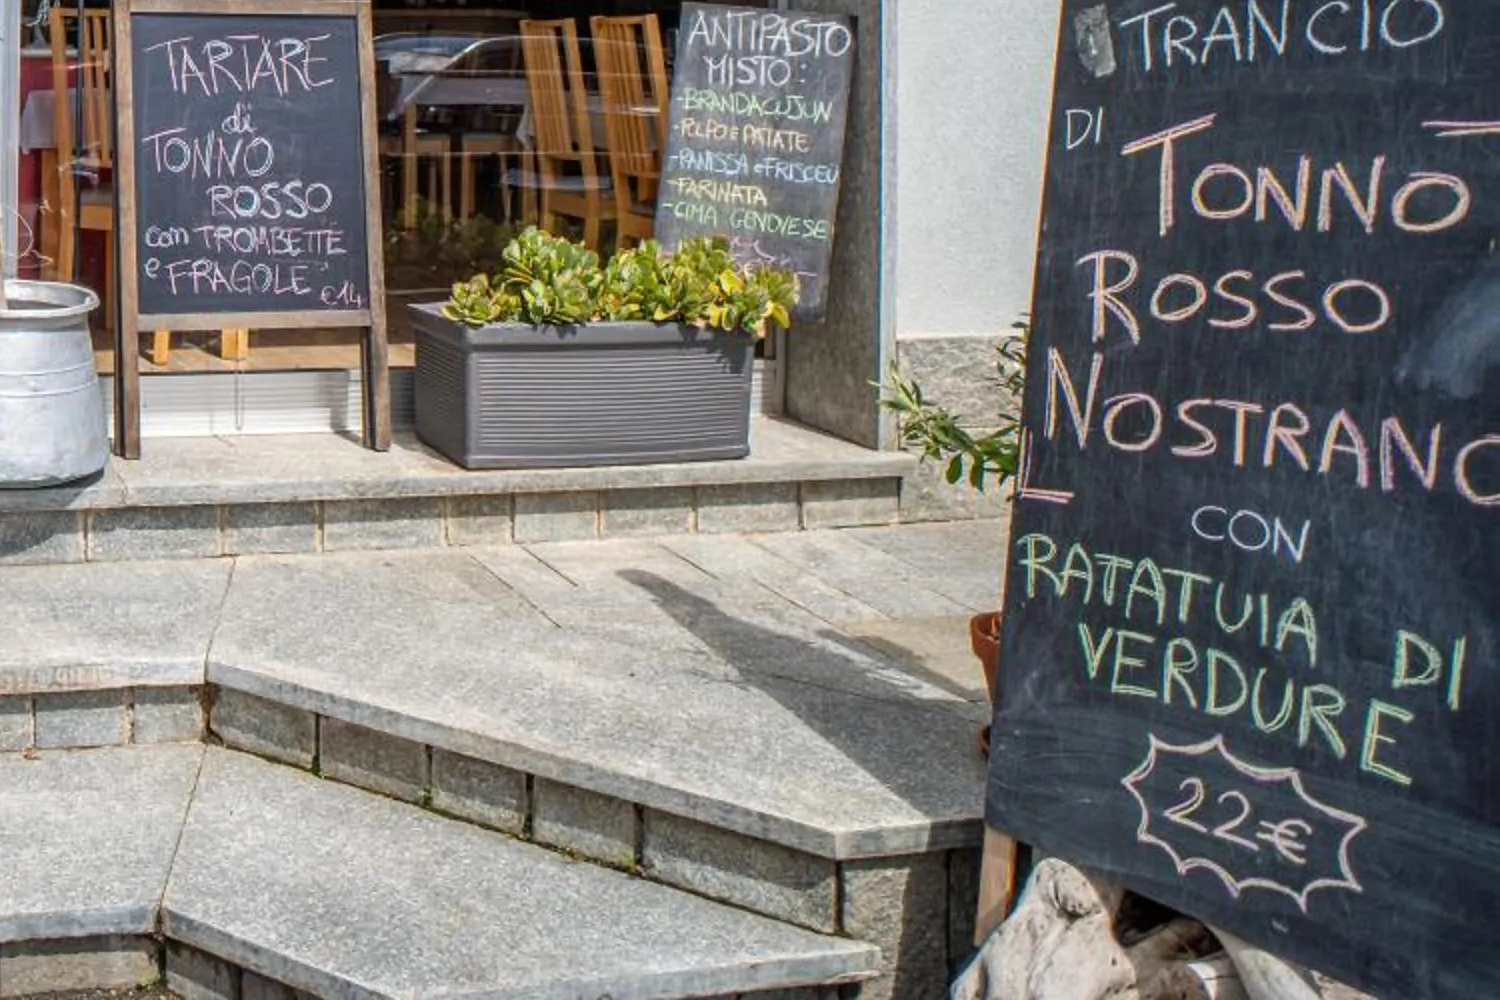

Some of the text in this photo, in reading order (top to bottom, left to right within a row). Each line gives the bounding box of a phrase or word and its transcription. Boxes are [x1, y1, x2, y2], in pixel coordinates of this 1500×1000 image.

[688, 10, 851, 57] ANTIPASTO
[144, 33, 334, 97] TARTARE
[222, 102, 258, 134] di
[743, 123, 810, 153] PATATE
[142, 128, 275, 179] TONNO
[1065, 106, 1471, 237] DI TONNO
[206, 182, 333, 219] ROSSO
[730, 207, 829, 239] GENOVESE
[145, 225, 347, 256] con TROMBETTE
[144, 257, 160, 278] e
[164, 258, 312, 295] FRAGOLE
[1075, 249, 1392, 345] ROSSO
[1191, 505, 1311, 563] CON
[1017, 533, 1466, 711] RATATUIA DI
[1079, 623, 1414, 785] VERDURE
[1163, 777, 1314, 864] 22€
